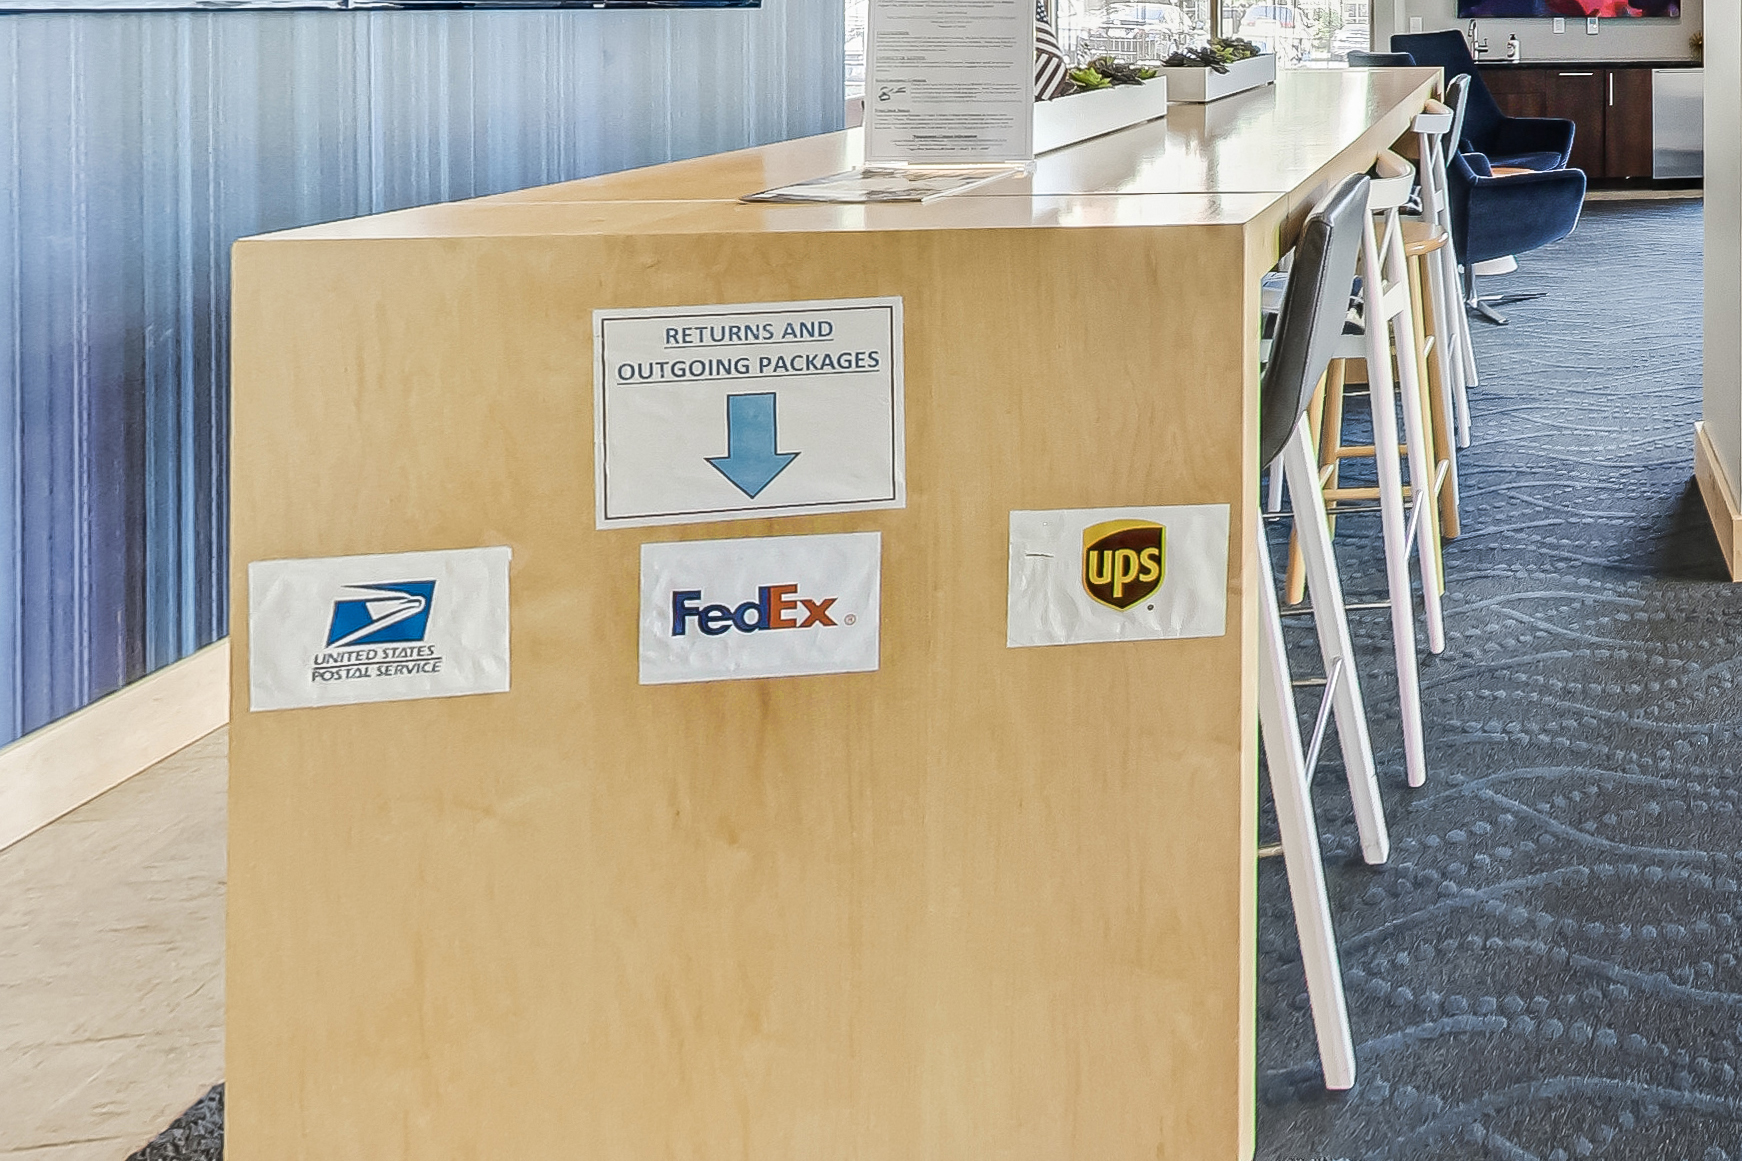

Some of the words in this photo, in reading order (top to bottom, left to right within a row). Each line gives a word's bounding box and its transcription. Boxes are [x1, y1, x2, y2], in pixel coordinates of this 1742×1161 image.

[665, 322, 774, 344] RETURNS
[781, 320, 833, 339] AND
[617, 356, 750, 381] OUTGOING
[759, 350, 880, 374] PACKAGES
[1088, 547, 1160, 598] ups
[672, 583, 838, 636] FedEx
[313, 649, 377, 665] UNITED
[382, 645, 435, 659] STATES
[311, 667, 372, 682] POSTAL
[377, 661, 442, 677] SERVICE
